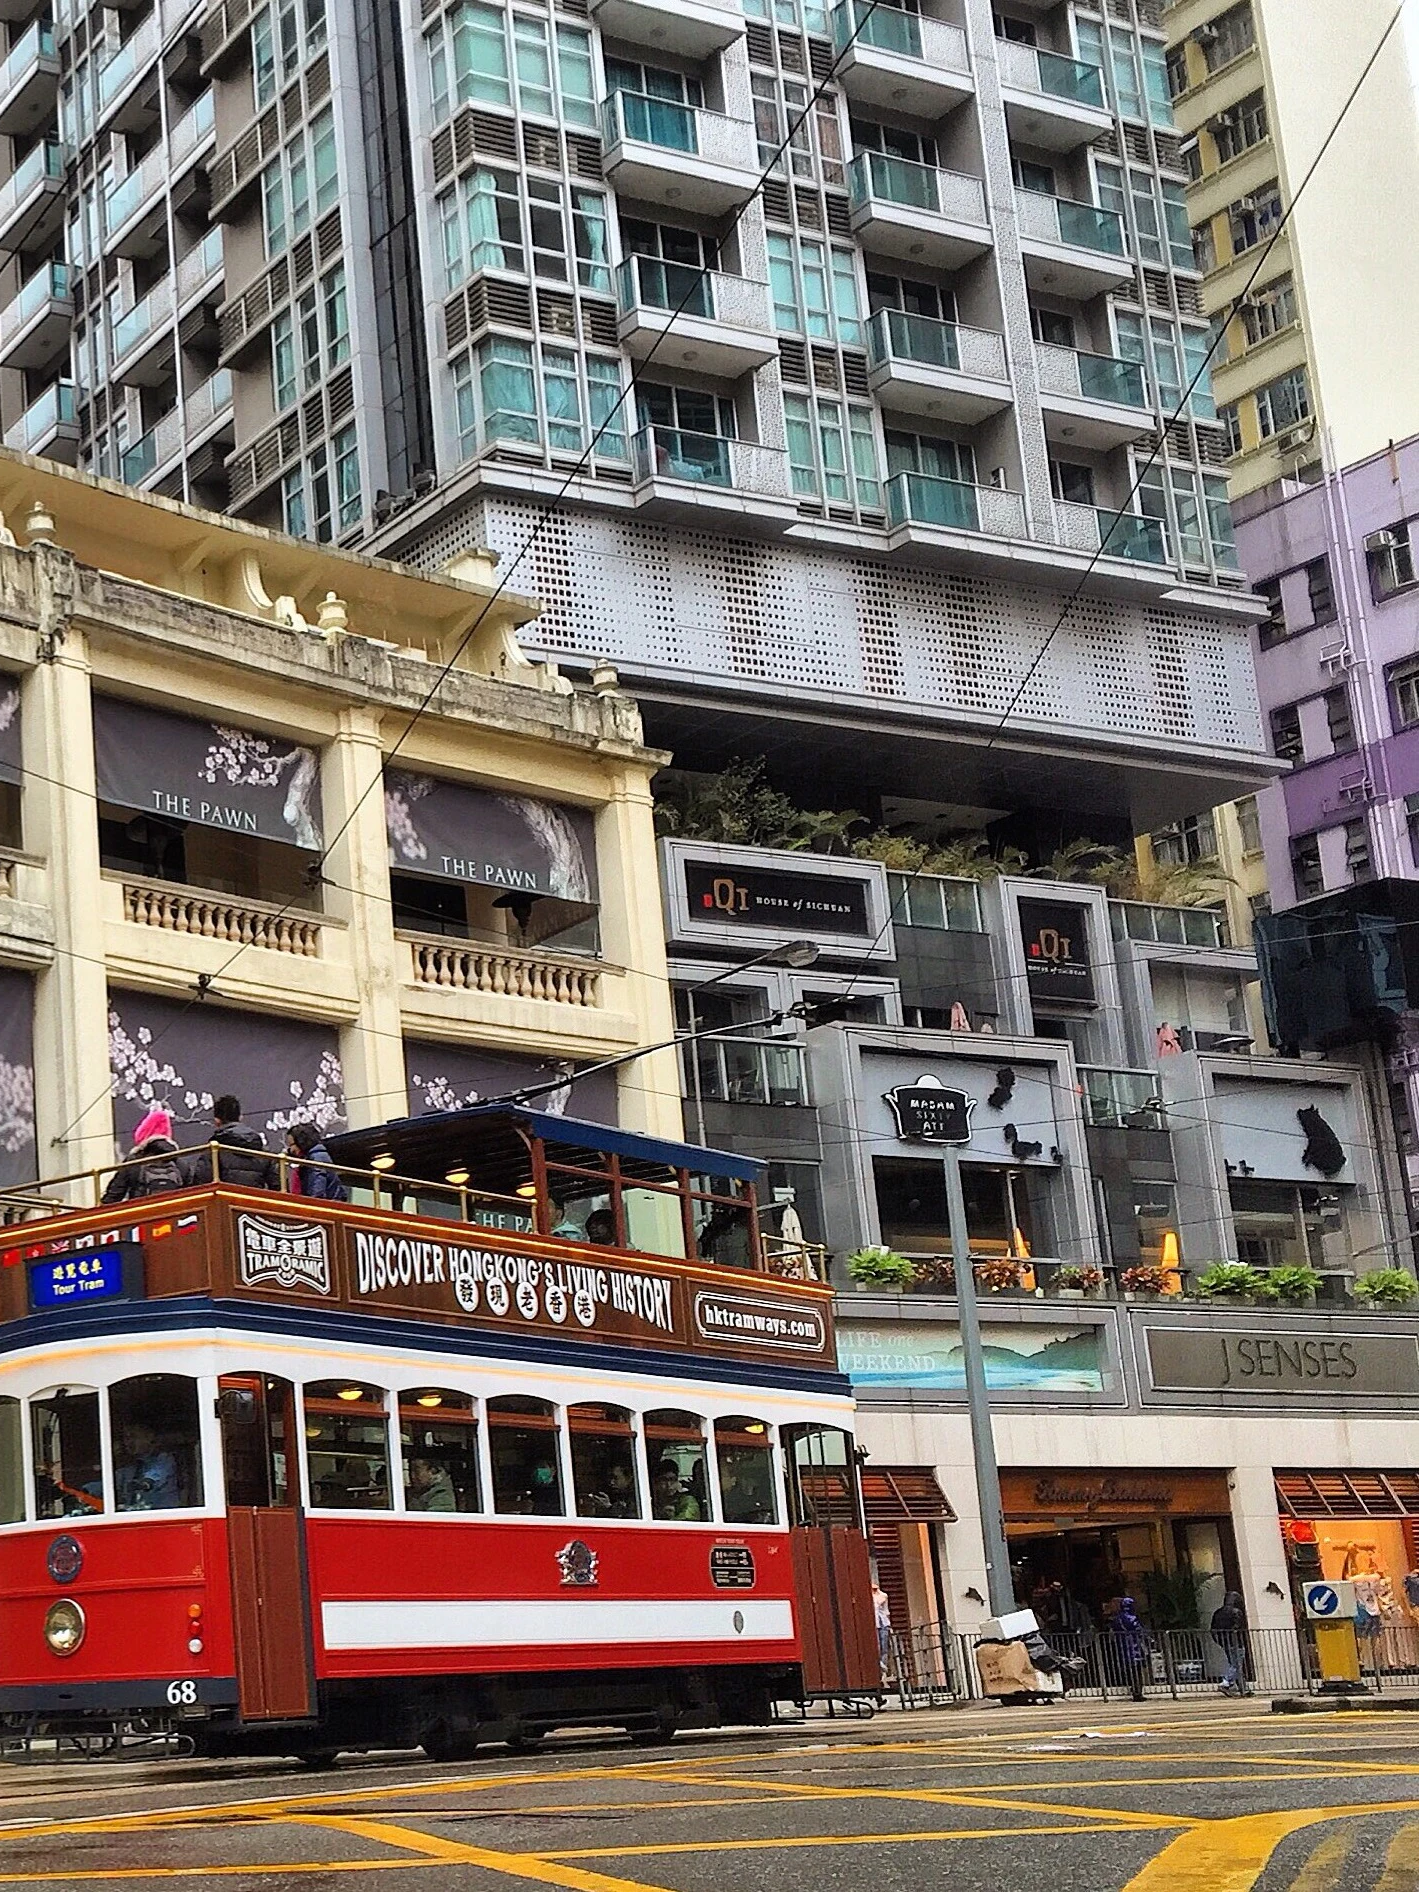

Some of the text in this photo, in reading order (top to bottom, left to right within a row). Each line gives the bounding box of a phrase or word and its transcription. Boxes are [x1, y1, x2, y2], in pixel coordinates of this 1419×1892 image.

[152, 790, 257, 831] THE PAWN
[441, 856, 536, 889] THE PAWN
[756, 896, 789, 907] HOUSE
[793, 899, 803, 911] of
[806, 902, 851, 913] SICHUAN
[910, 1099, 955, 1110] MADAM
[475, 1212, 506, 1229] HE
[52, 1279, 104, 1295] Tour Tram
[355, 1232, 445, 1294] DISCOVER
[556, 1263, 608, 1304] LIVING
[610, 1271, 674, 1333] HISTORY
[704, 1304, 817, 1338] hktramways.com
[1238, 1339, 1357, 1378] SENSES
[167, 1681, 196, 1704] 68
